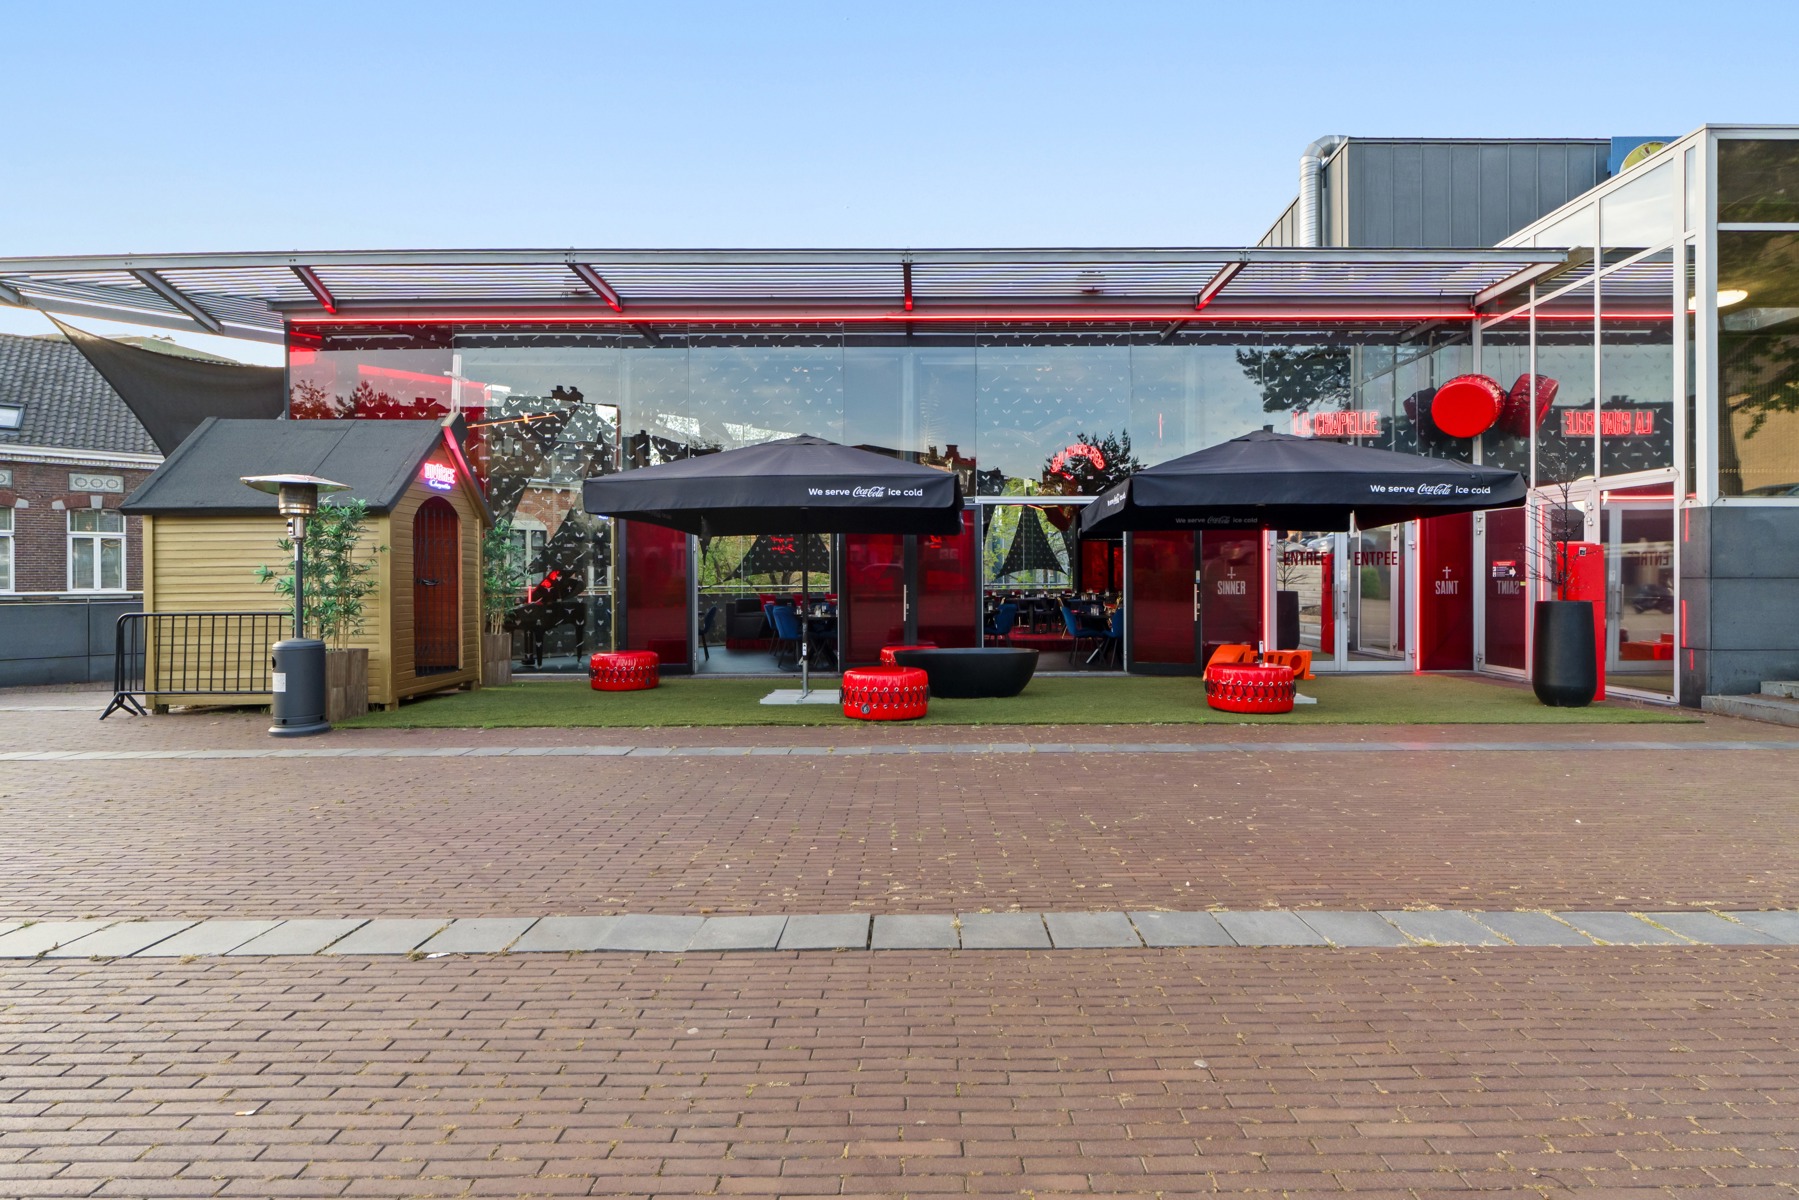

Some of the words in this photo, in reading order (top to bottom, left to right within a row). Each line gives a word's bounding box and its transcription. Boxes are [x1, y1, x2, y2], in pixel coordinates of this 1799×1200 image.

[1293, 411, 1311, 435] LA
[1314, 411, 1379, 436] CHAPELLE
[807, 487, 824, 497] We
[825, 488, 851, 497] serve
[888, 487, 902, 497] ice
[903, 488, 924, 498] cold
[1369, 484, 1386, 494] We
[1387, 485, 1415, 494] serve
[1455, 485, 1469, 495] ice
[1471, 485, 1492, 495] cold
[1283, 551, 1329, 566] ENTREE
[1217, 580, 1246, 595] SINNER
[1435, 580, 1459, 595] SAINT
